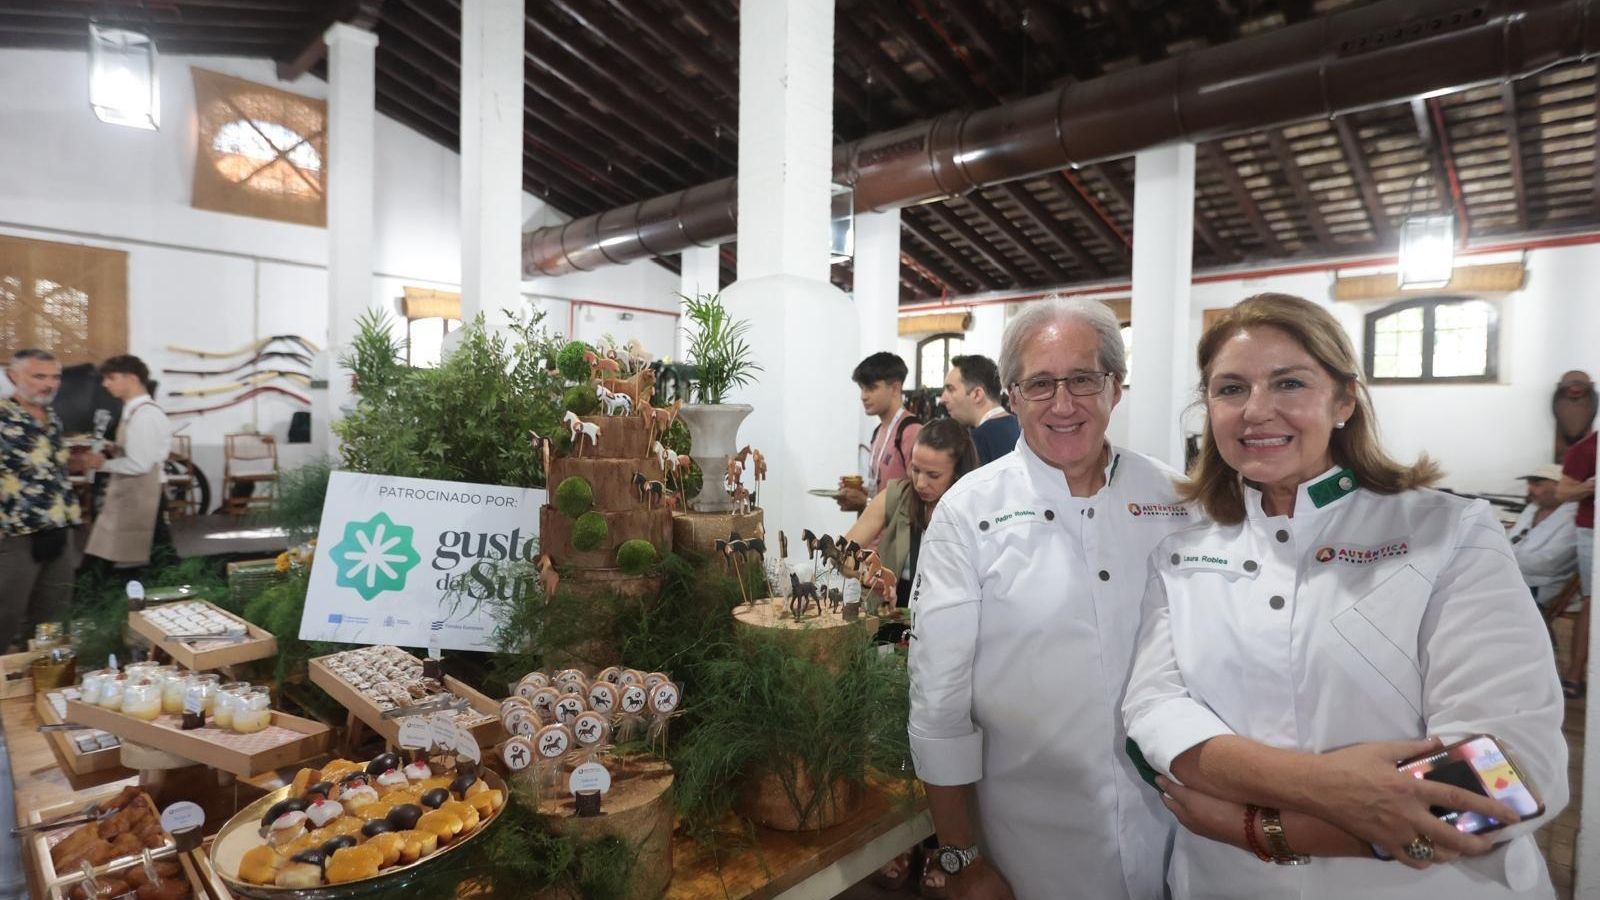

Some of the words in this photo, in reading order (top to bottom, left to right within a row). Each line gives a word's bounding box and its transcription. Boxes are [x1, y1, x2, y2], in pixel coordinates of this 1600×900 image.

[379, 486, 482, 505] PATROCINADO
[485, 495, 519, 508] POR:
[1201, 556, 1228, 565] Robles
